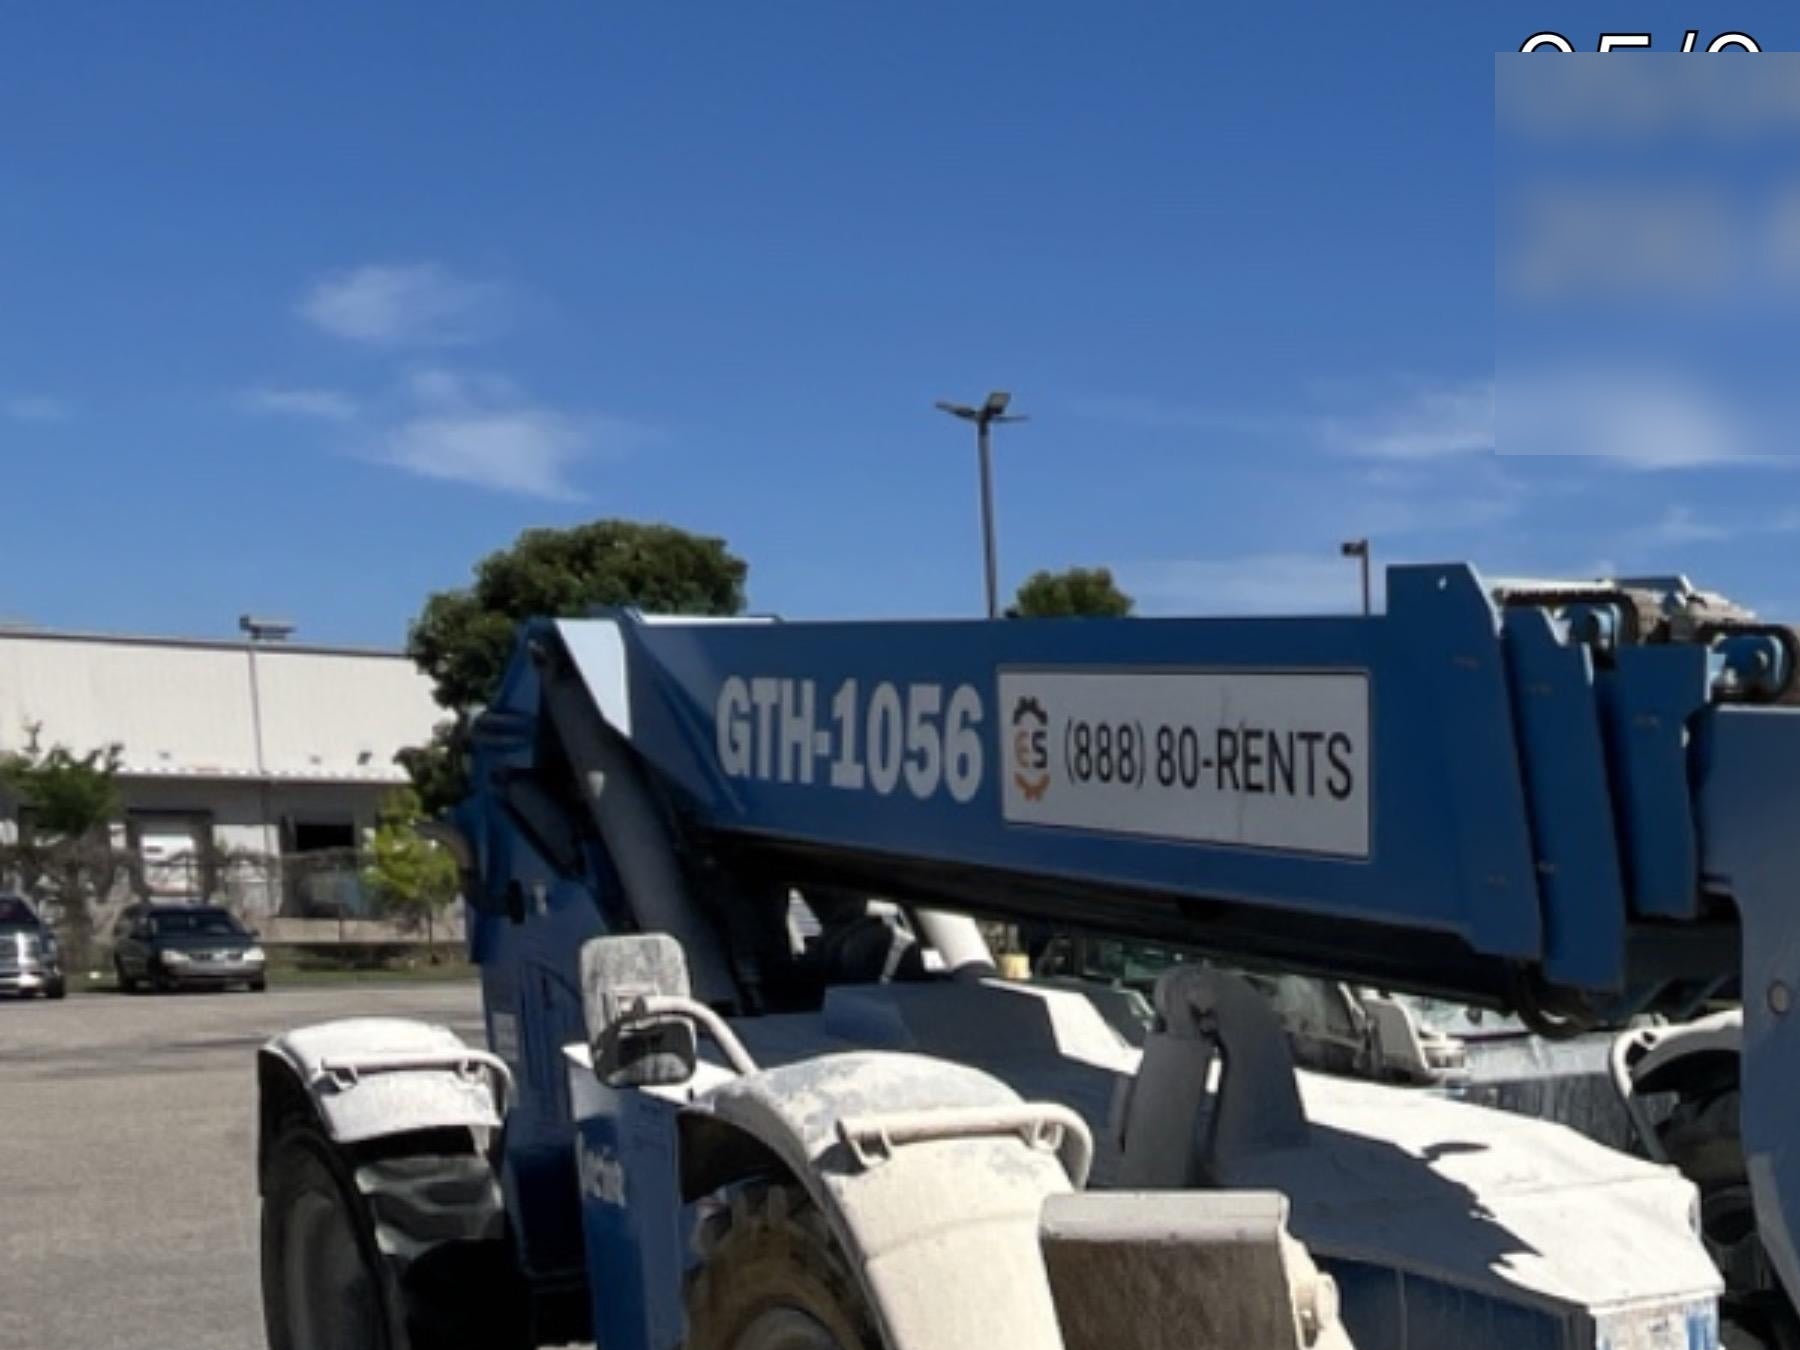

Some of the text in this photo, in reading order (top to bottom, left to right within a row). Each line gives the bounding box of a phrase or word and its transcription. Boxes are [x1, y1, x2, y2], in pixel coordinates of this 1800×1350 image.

[716, 674, 984, 803] GTH-1056
[1064, 716, 1354, 801] (888) 80-RENTS
